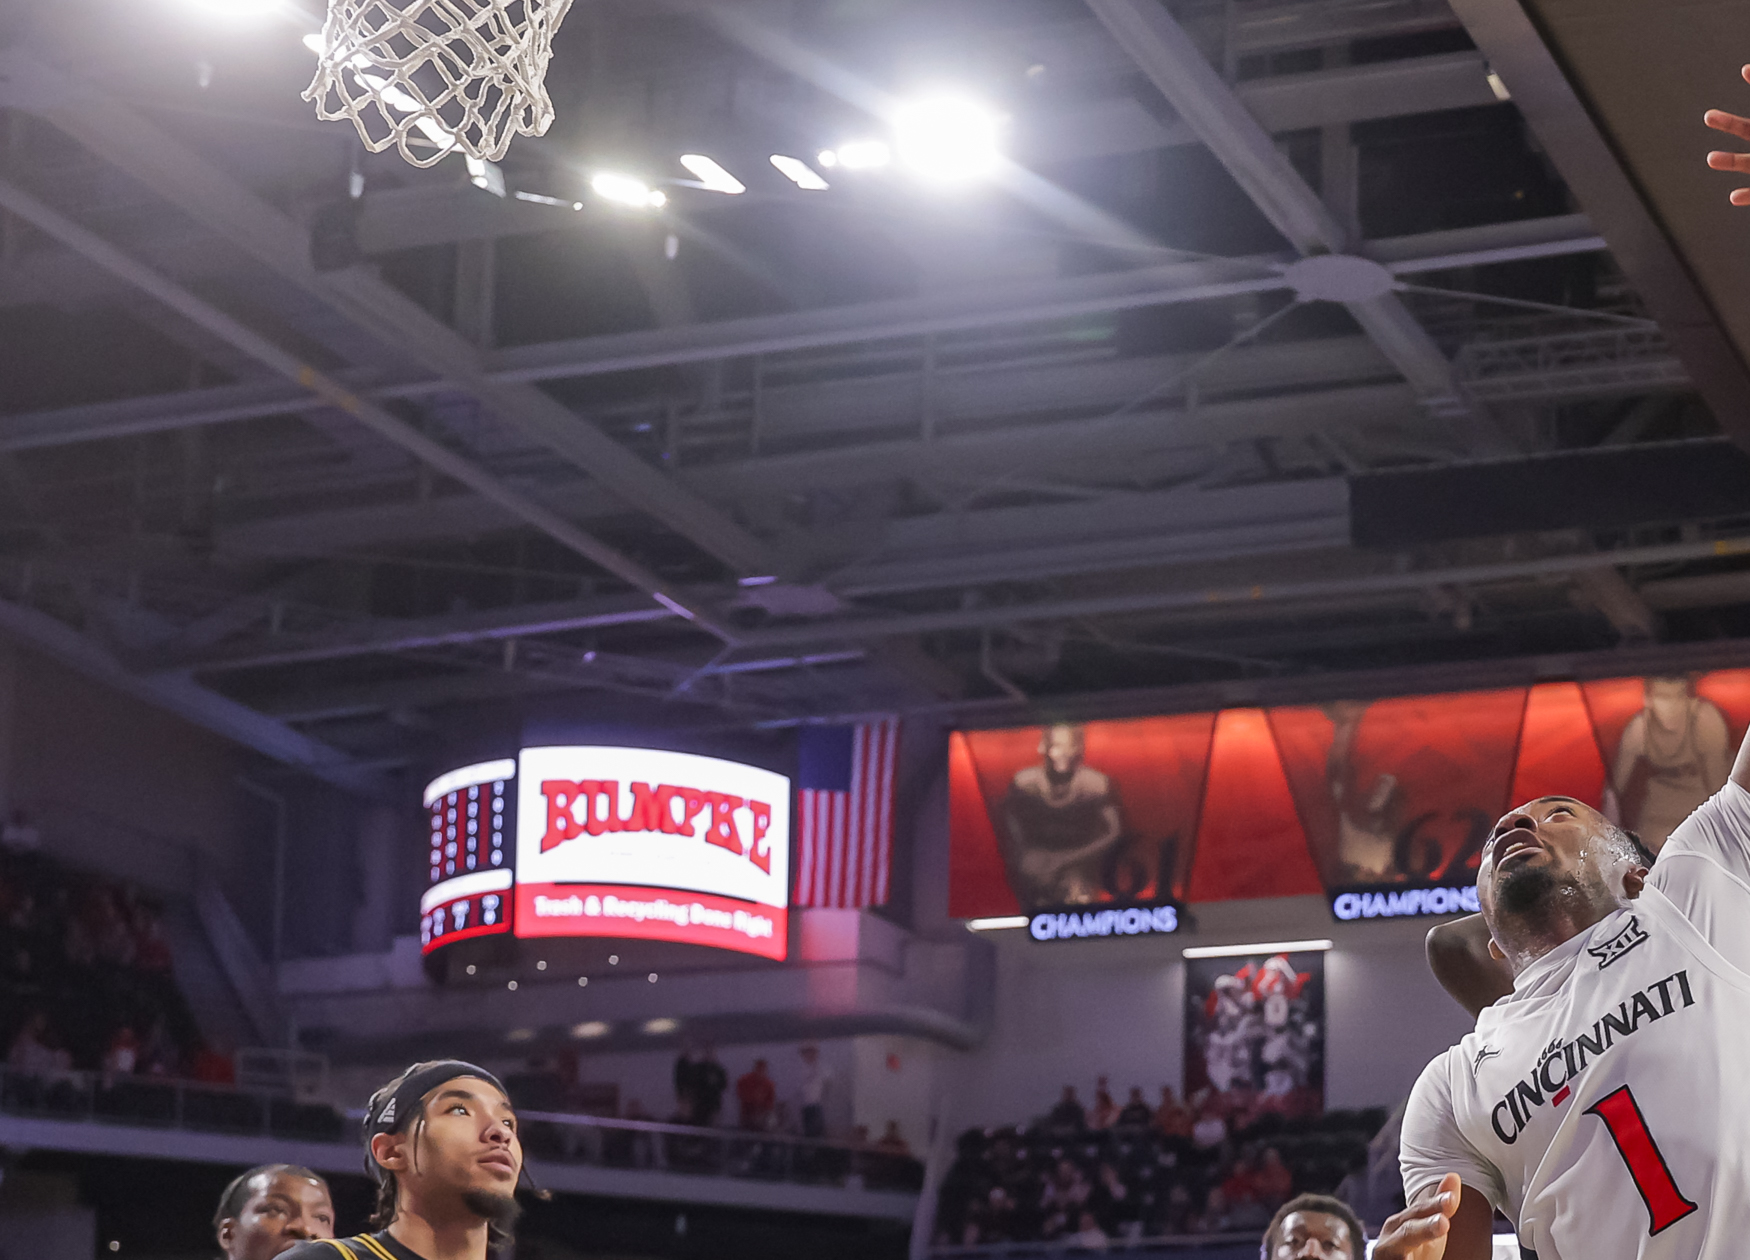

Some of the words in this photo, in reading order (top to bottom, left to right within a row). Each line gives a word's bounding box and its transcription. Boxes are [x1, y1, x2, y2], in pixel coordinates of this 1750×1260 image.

[540, 779, 771, 875] RUMPKE
[1030, 906, 1178, 941] CHAMPIONS
[1491, 970, 1696, 1145] CINCINNATI
[1582, 1084, 1698, 1236] 1
